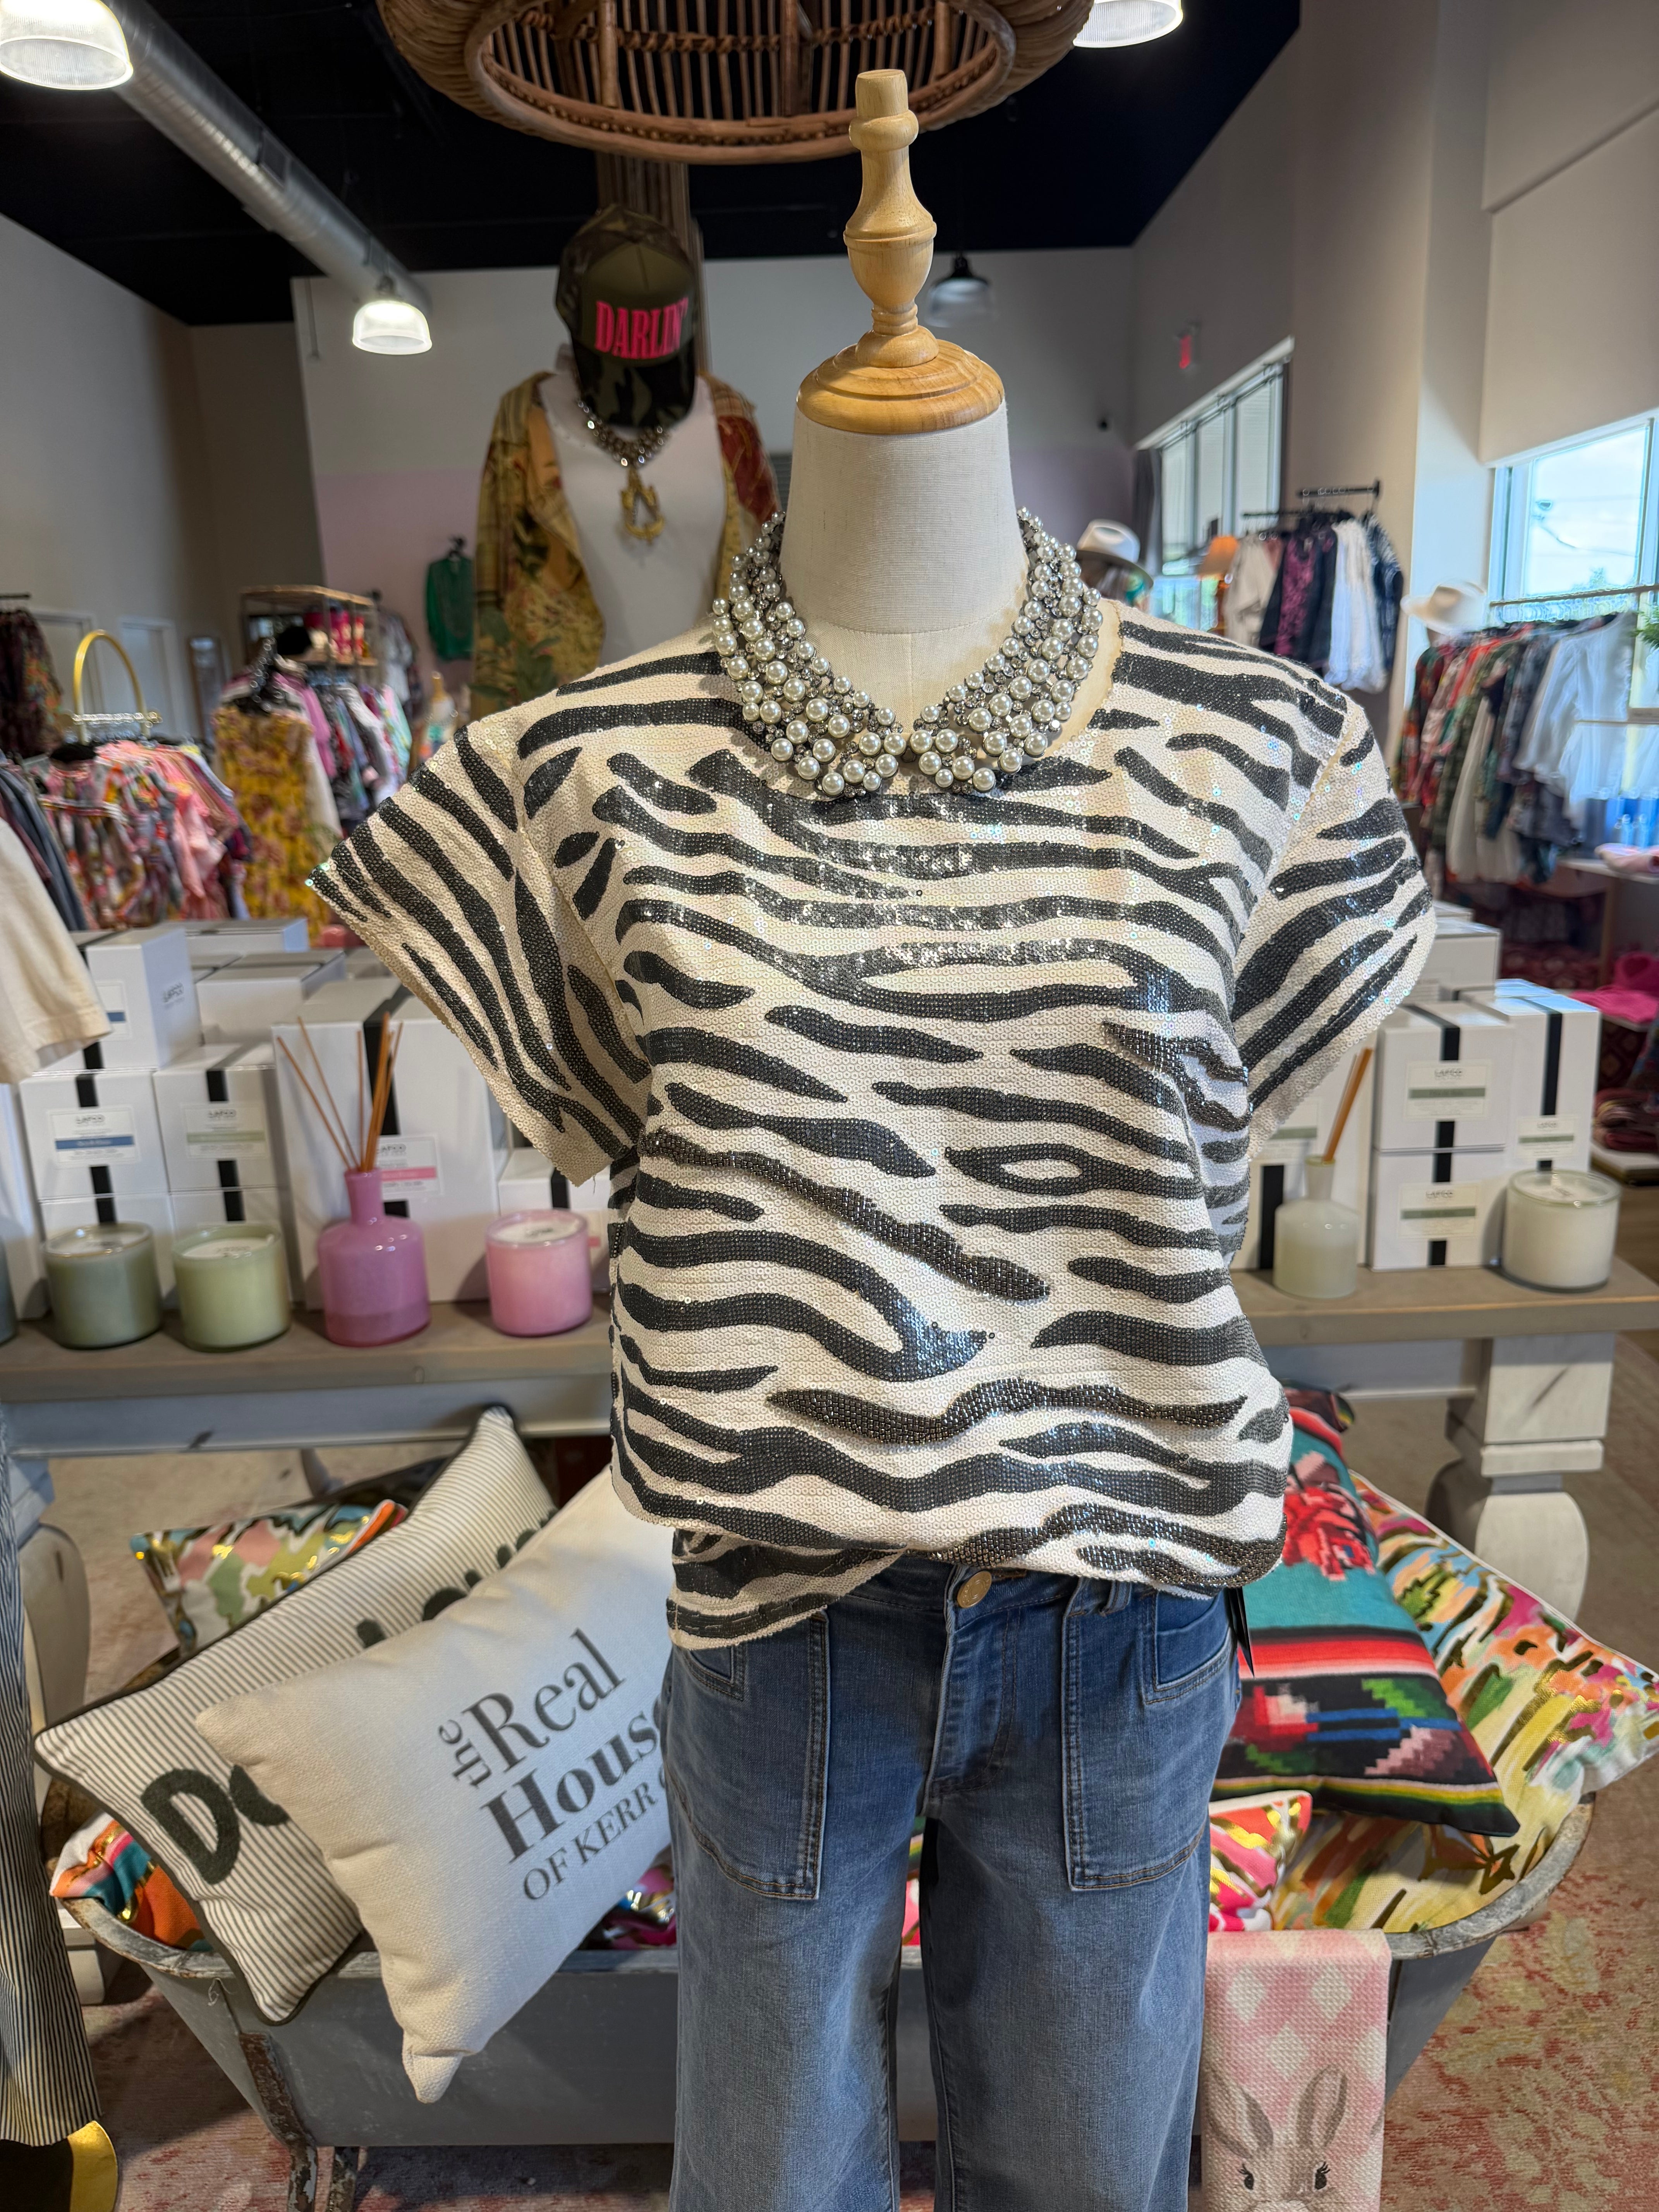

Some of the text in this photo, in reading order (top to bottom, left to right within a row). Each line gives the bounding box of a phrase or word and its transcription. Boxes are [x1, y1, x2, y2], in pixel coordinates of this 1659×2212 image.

[438, 1628, 625, 1789] the Real
[523, 1782, 657, 1900] OF KERR
